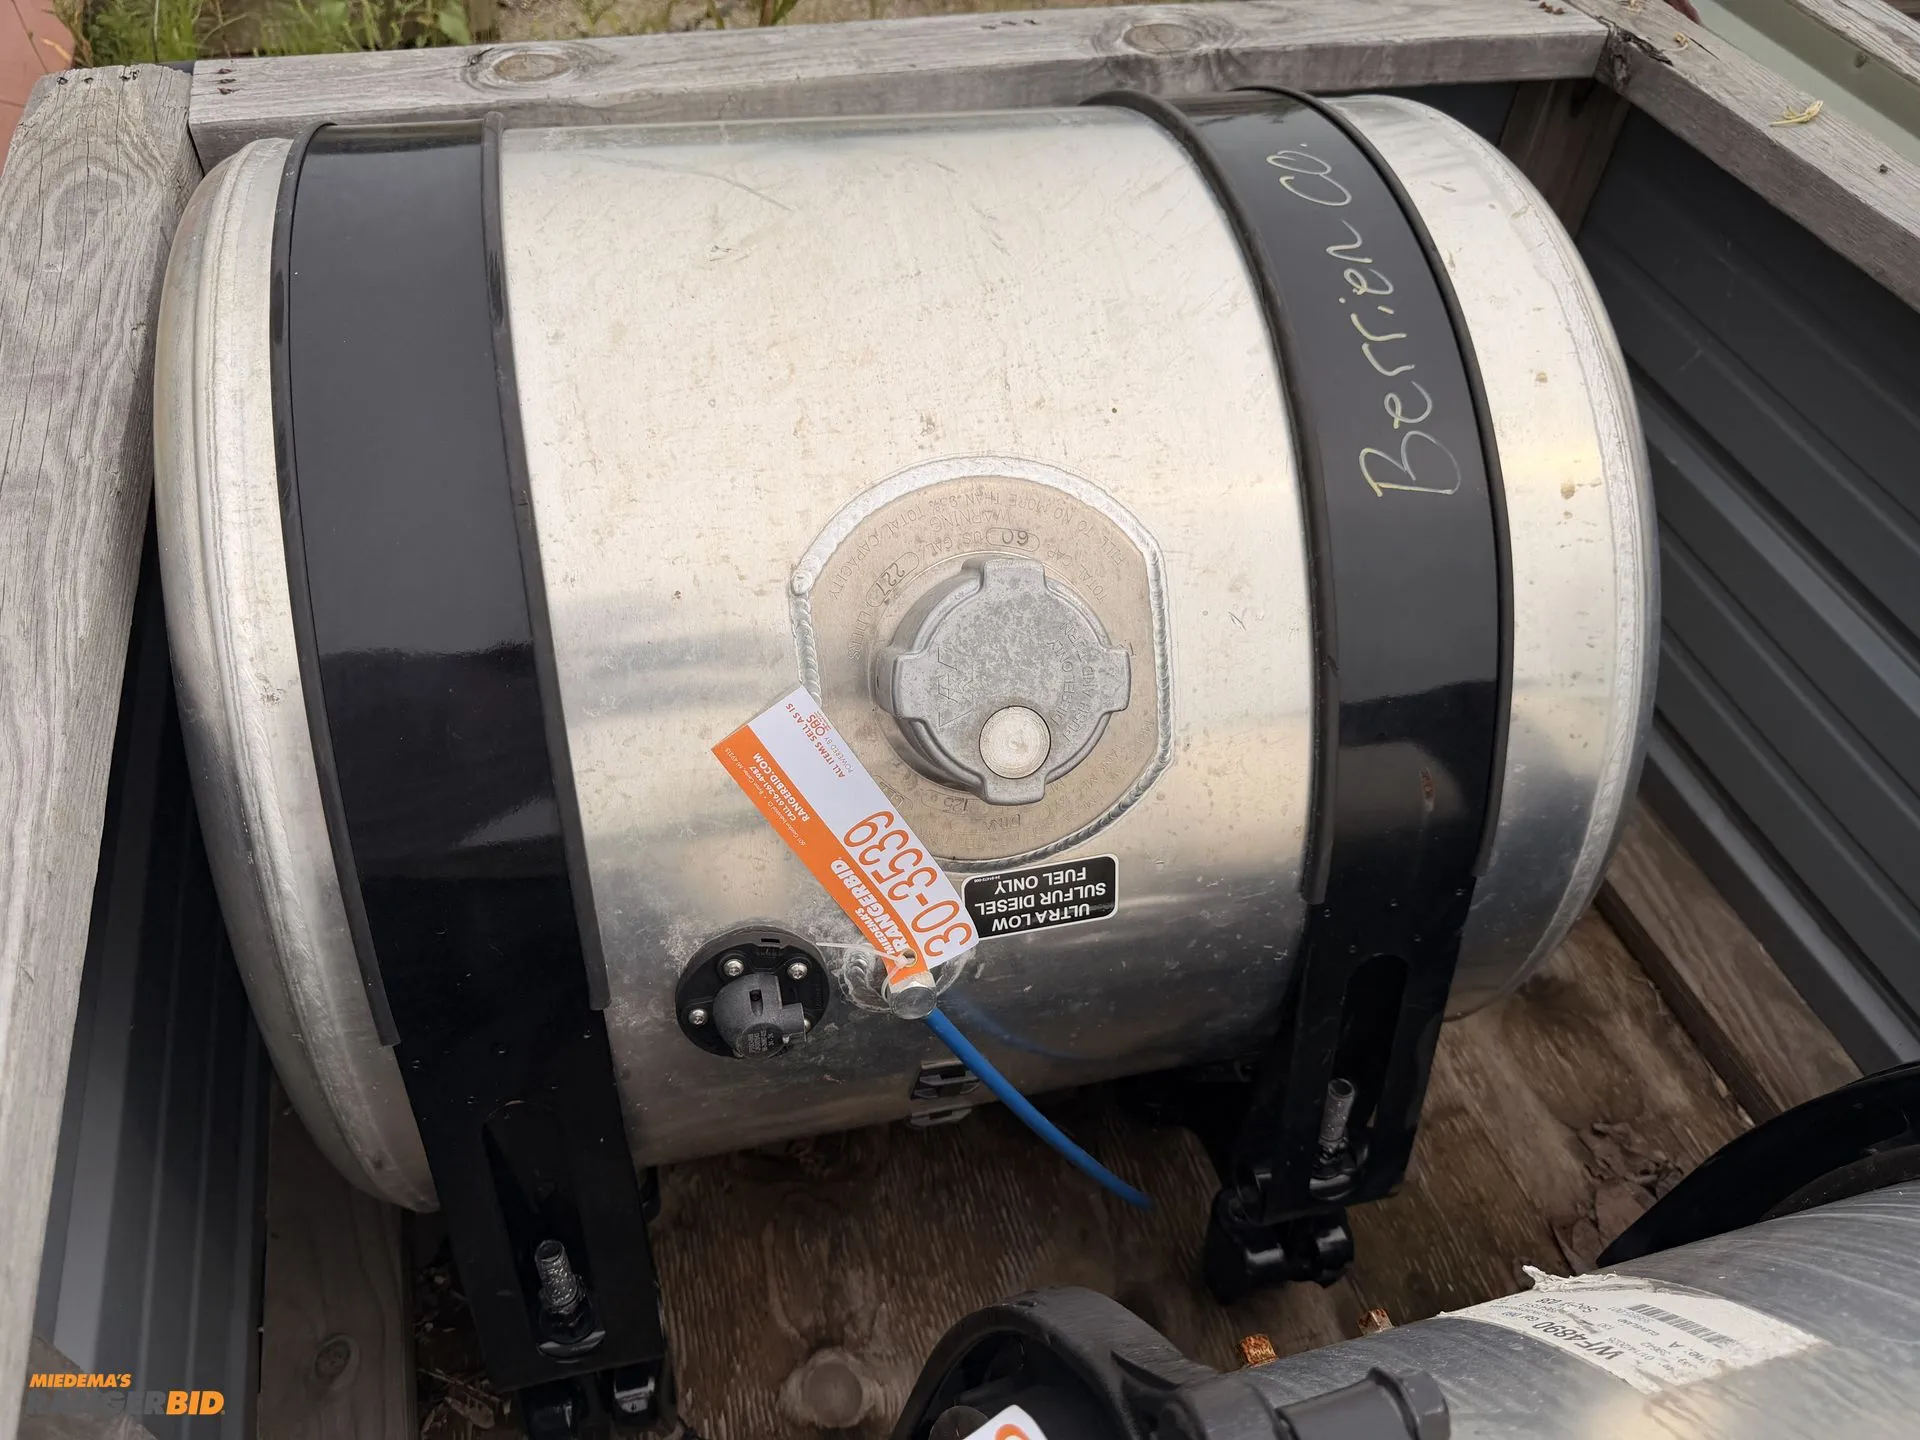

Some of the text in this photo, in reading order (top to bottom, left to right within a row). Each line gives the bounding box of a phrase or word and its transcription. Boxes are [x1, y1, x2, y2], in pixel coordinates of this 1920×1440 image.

[1266, 143, 1461, 497] Berrien Co.
[1001, 529, 1030, 545] 60
[877, 563, 906, 597] 227
[785, 703, 794, 713] IS
[793, 712, 804, 724] AS
[802, 724, 817, 742] SELL
[824, 736, 833, 745] BY
[815, 741, 833, 765] ITEMS
[830, 745, 854, 773] POWERED
[832, 763, 845, 778] ALL
[749, 765, 797, 822] CALL 616-261-4987
[753, 752, 810, 822] RANGERBID.COM
[843, 811, 972, 957] 30-3539
[994, 866, 1087, 895] FUEL ONLY
[830, 858, 910, 953] RANGERBID
[974, 882, 1107, 916] SULFUR DIESEL
[855, 908, 895, 954] MIEDEMA'S
[992, 903, 1091, 932] ULTRA LOW
[1532, 1321, 1625, 1360] WF4890
